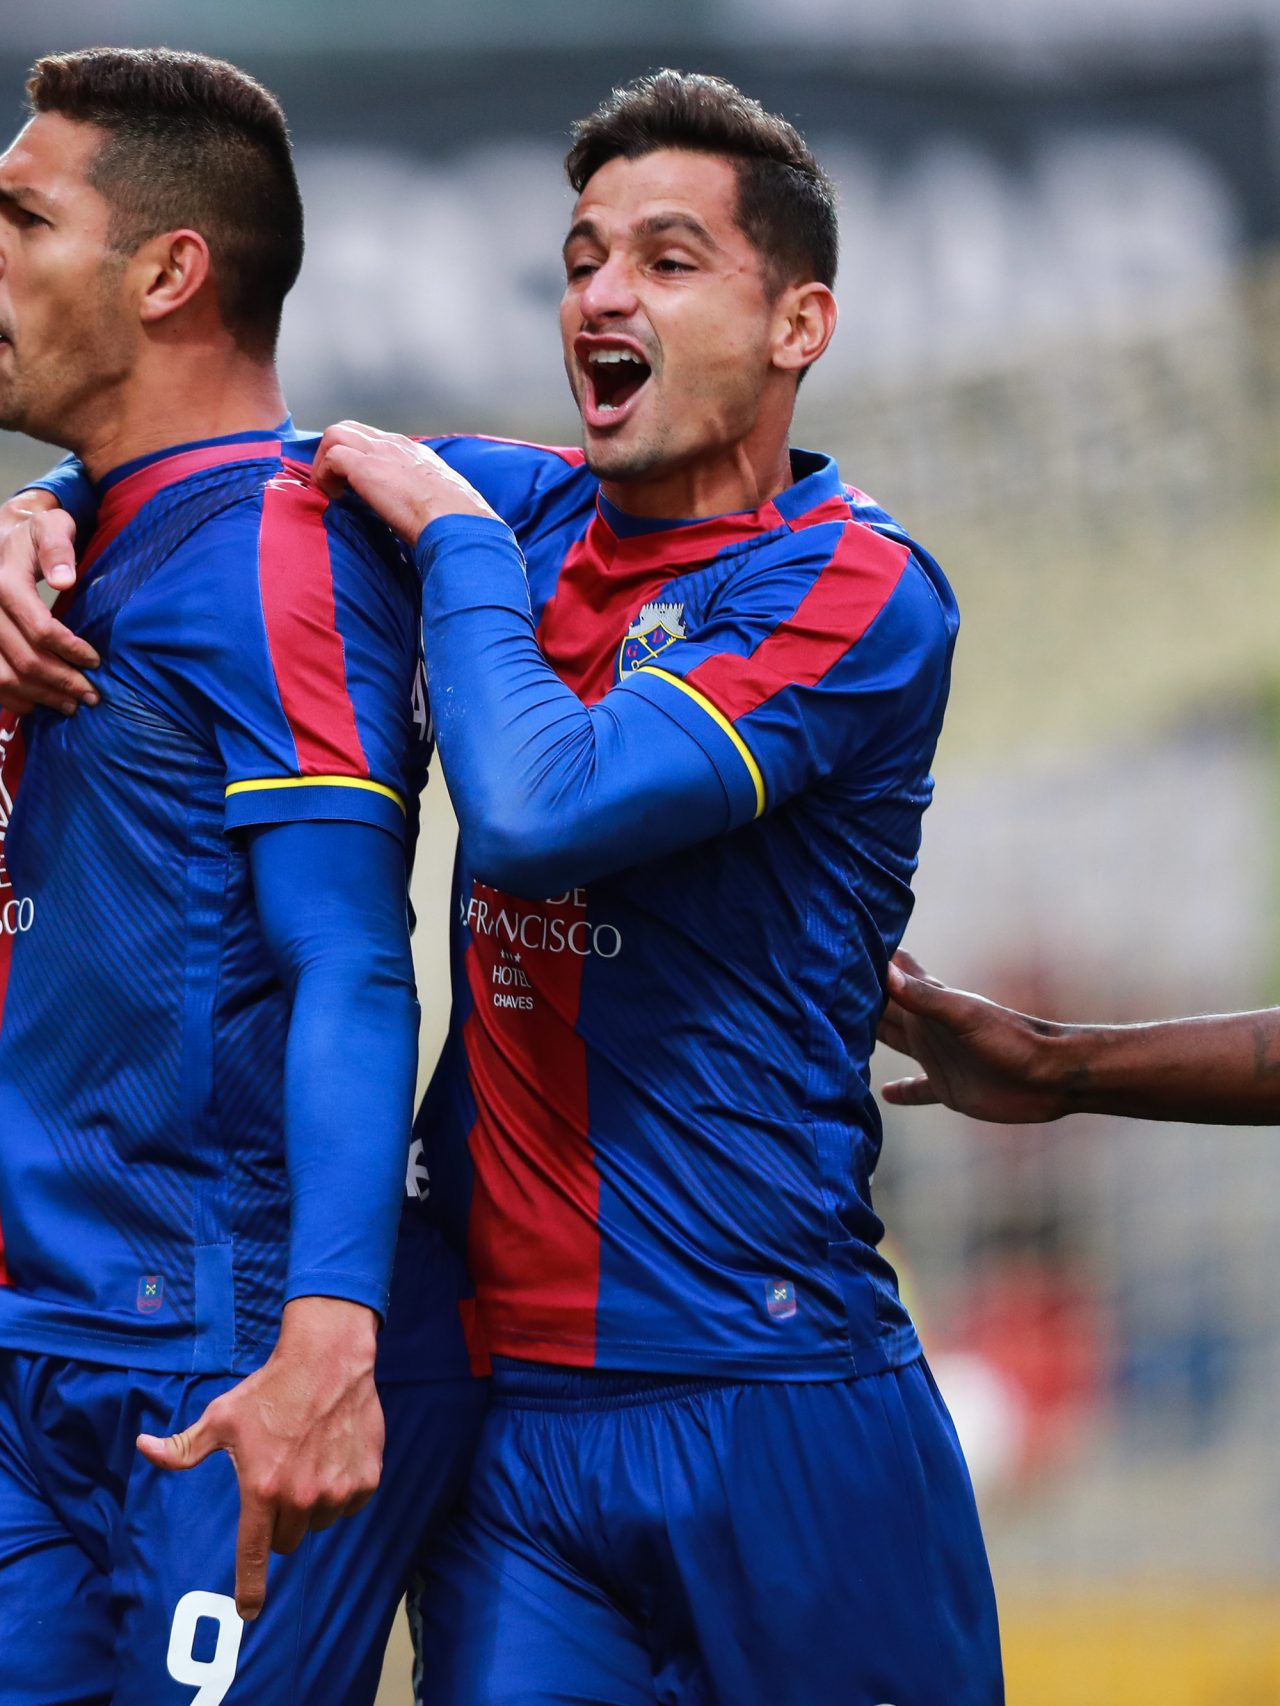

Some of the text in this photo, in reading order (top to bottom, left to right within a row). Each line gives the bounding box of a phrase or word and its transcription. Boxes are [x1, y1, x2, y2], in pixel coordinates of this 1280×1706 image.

[492, 964, 533, 989] HOTEL
[493, 992, 534, 1011] CHAVES
[166, 1590, 244, 1706] 9
